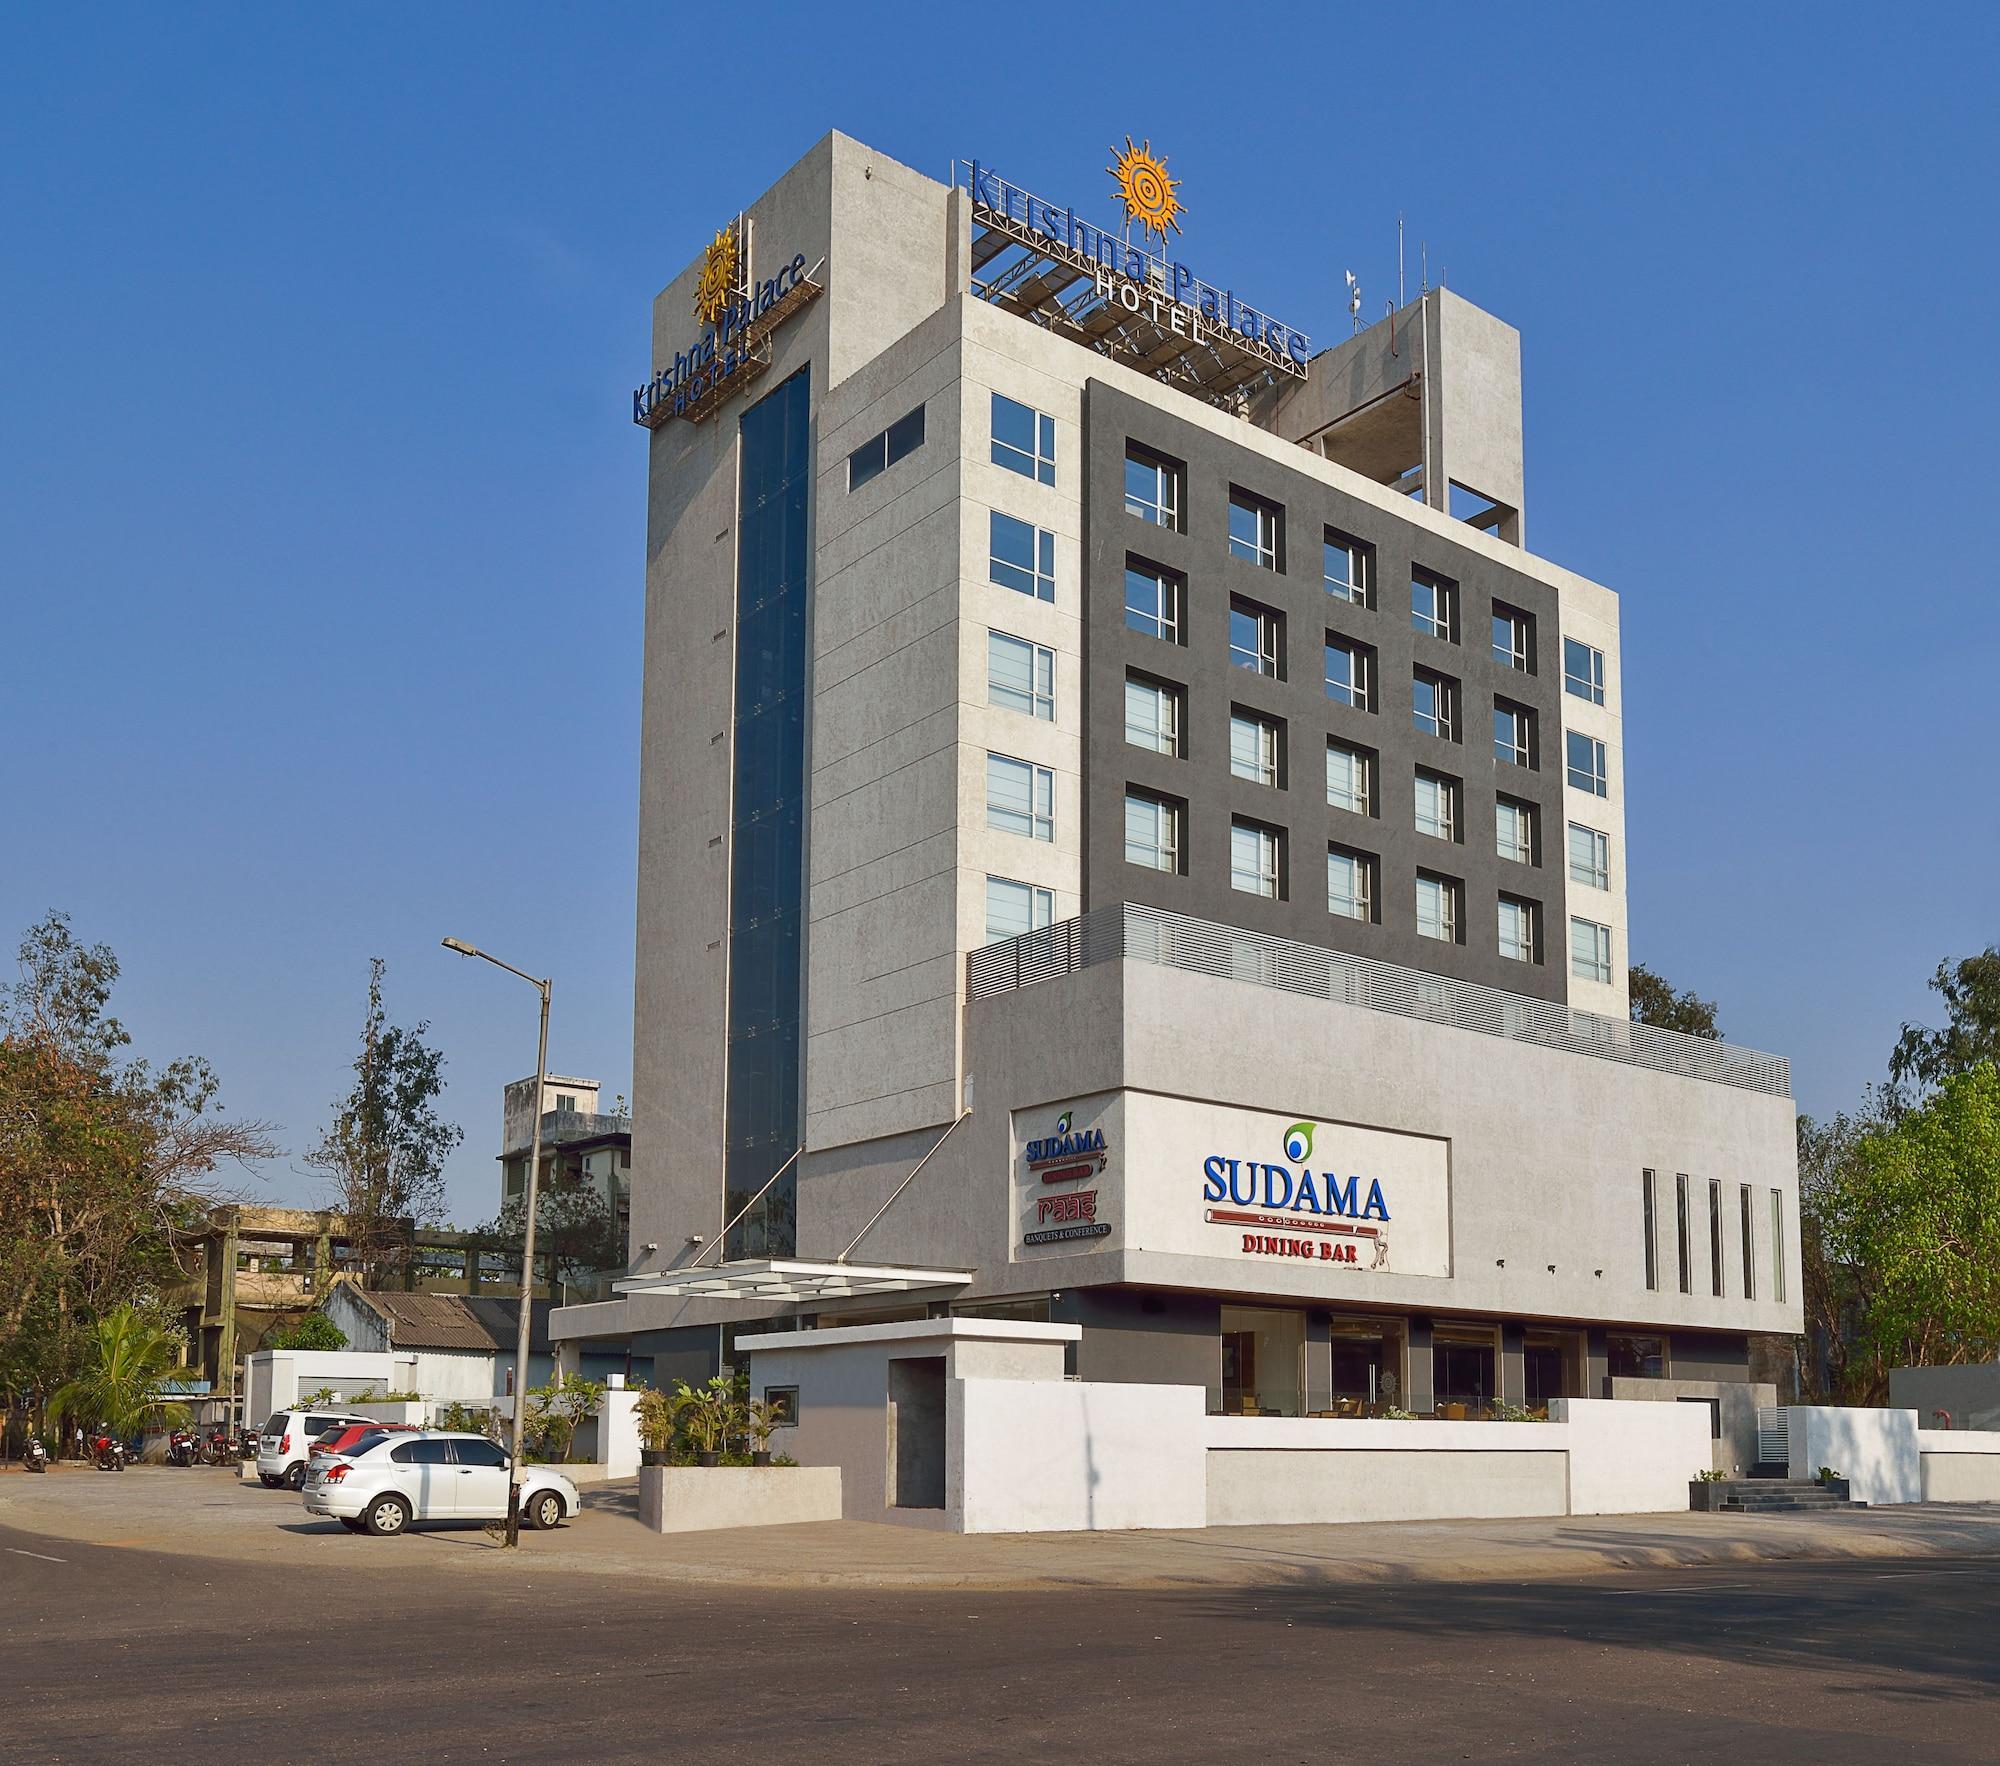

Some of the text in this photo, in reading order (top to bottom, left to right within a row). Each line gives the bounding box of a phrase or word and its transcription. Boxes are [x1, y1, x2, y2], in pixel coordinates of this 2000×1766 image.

[972, 159, 1310, 366] Krishna Palace
[633, 253, 806, 423] Krishna Palace
[1096, 270, 1207, 347] HOTEL
[675, 342, 750, 416] HOTEL
[1026, 1128, 1108, 1162] SUDAMA
[1203, 1155, 1392, 1221] SUDAMA
[1025, 1223, 1107, 1244] BANQUETS & CONFERENCE
[1242, 1234, 1359, 1263] DINING BAR
